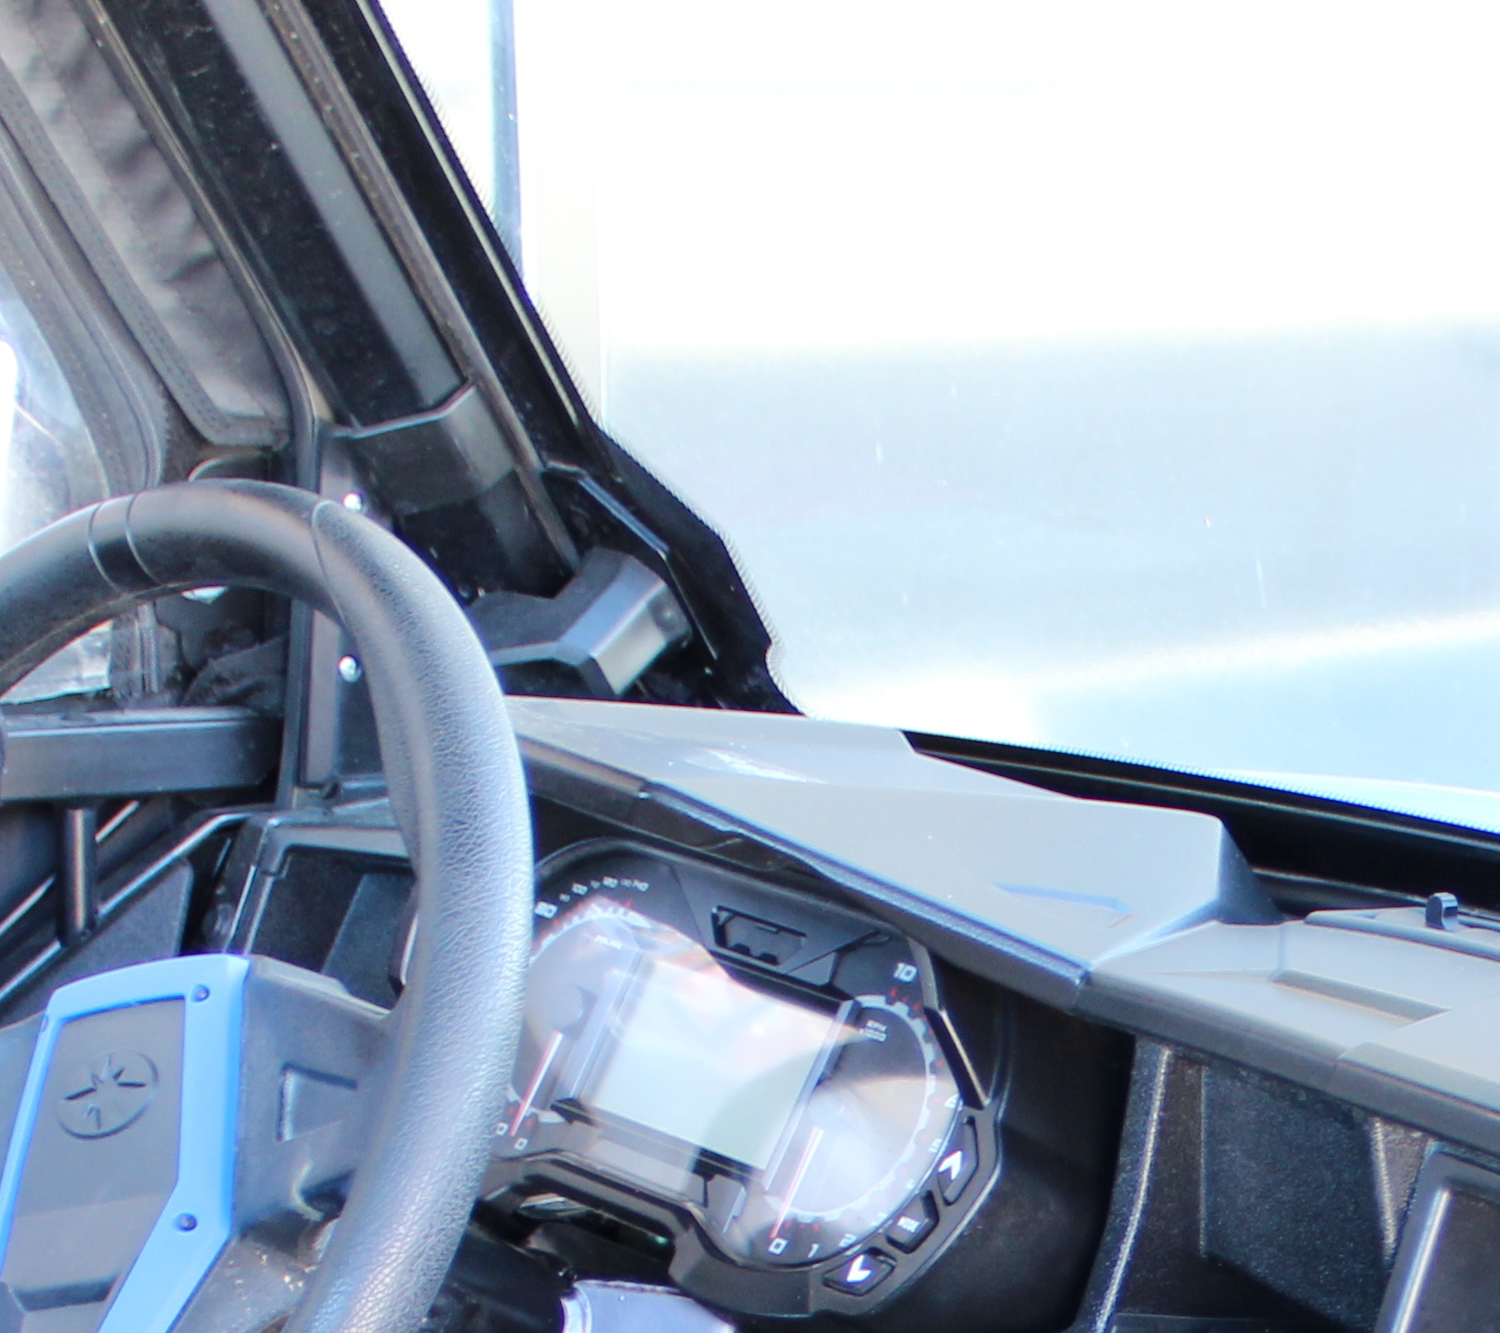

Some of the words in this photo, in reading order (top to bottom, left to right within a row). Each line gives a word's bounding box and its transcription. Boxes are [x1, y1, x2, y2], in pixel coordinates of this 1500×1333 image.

[893, 962, 918, 982] 10
[767, 1237, 789, 1256] 0
[837, 1232, 858, 1249] 2
[807, 1242, 821, 1259] 1
